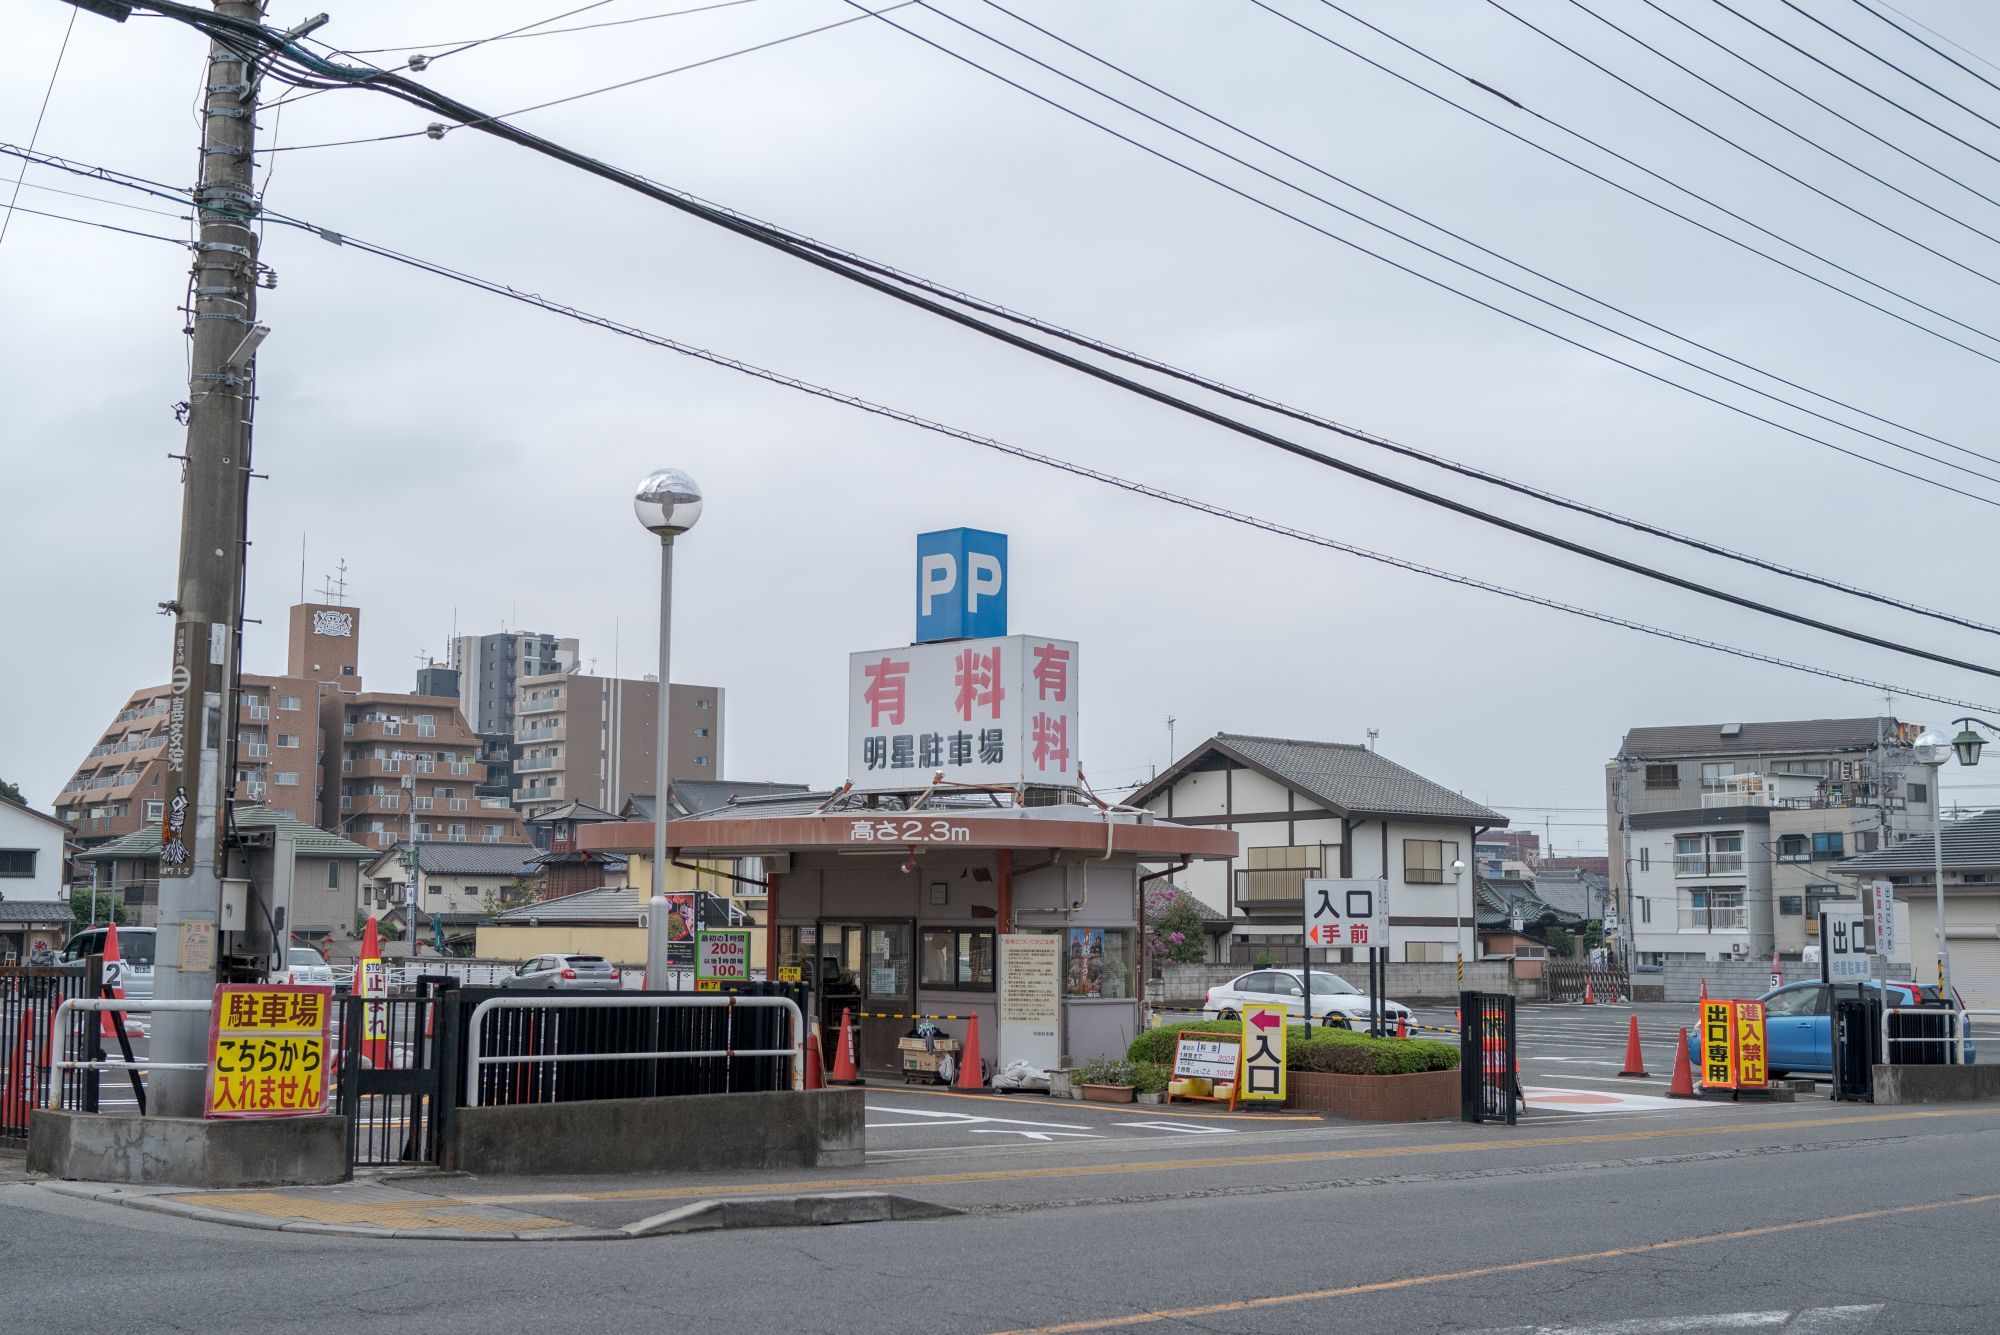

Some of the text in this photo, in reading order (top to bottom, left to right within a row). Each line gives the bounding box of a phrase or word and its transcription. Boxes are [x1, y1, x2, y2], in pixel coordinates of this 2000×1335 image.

[921, 553, 957, 617] P
[967, 551, 1002, 613] P
[863, 646, 1005, 728] 有料
[1032, 643, 1070, 773] 有料
[168, 697, 184, 772] 喜多院
[863, 728, 1004, 771] 明星駐車場
[851, 820, 970, 841] 高さ2.3m
[1313, 890, 1373, 918] 入口
[711, 943, 744, 955] 200円
[1322, 923, 1369, 944] 手前
[106, 964, 120, 986] 2
[712, 965, 744, 976] 100円
[1771, 976, 1778, 986] 5
[1833, 960, 1868, 975] 明星駐車場
[227, 993, 319, 1028] 駐車場
[217, 1039, 320, 1072] こちらから
[1708, 1005, 1728, 1082] 出口専用
[1740, 1004, 1762, 1082] 進入禁止
[1246, 1035, 1282, 1095] 入口
[213, 1074, 320, 1110] 入れません
